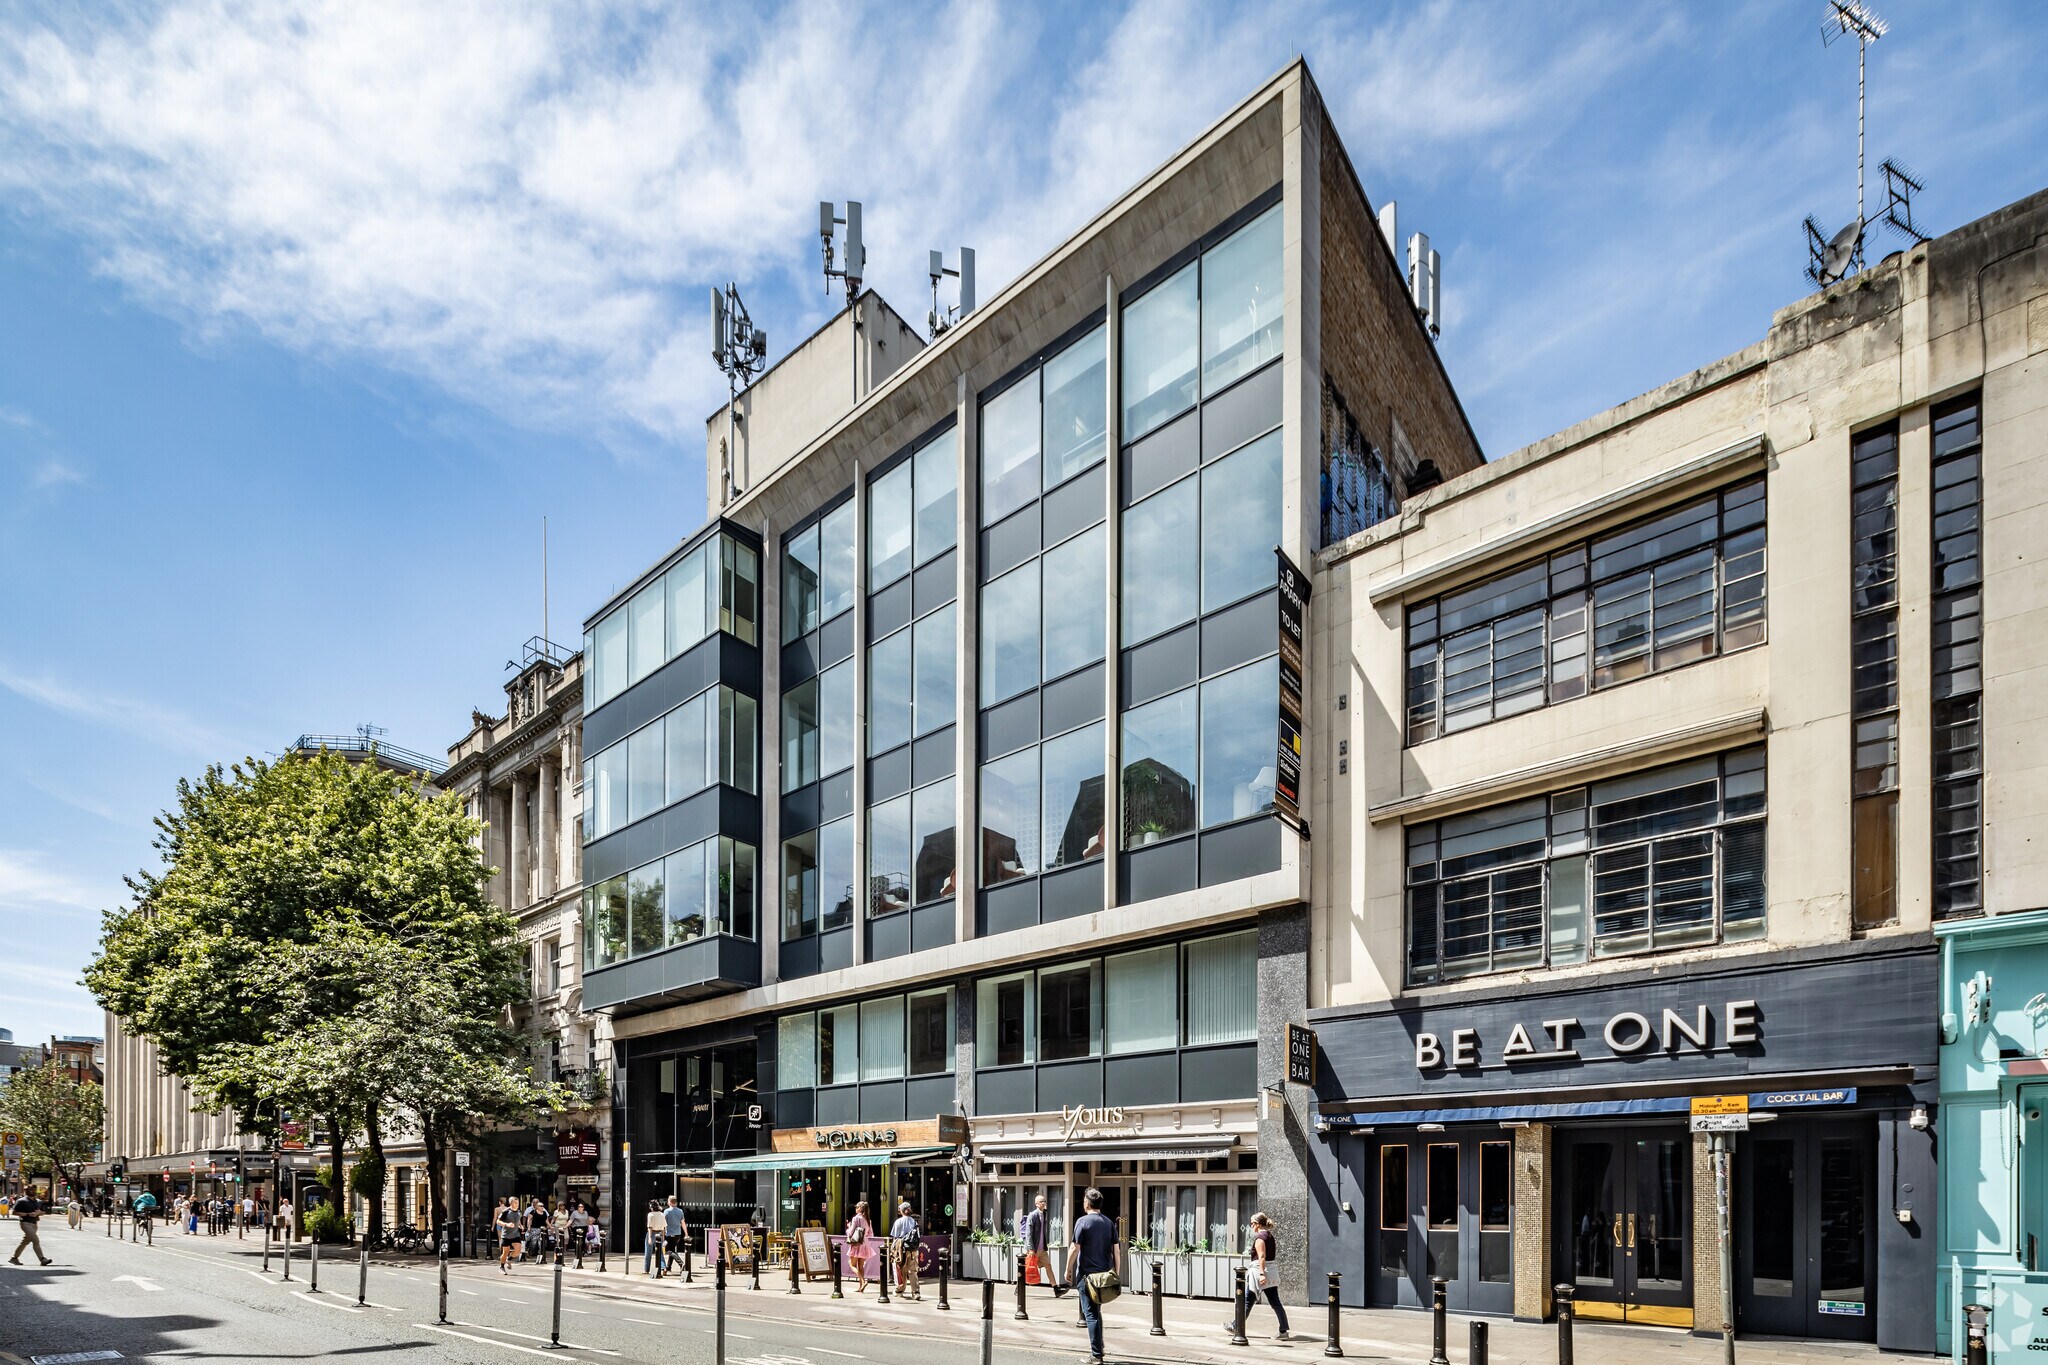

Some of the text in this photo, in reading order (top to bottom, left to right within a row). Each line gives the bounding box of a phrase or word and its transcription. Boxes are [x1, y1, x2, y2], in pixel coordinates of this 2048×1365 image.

[1281, 609, 1301, 640] TO LET
[1291, 1030, 1310, 1043] BE AT
[1416, 1000, 1756, 1069] BE AT ONE
[1291, 1041, 1310, 1058] ONE
[1291, 1063, 1310, 1081] BAR
[1766, 1092, 1844, 1104] COCKTAIL BAR
[1063, 1104, 1124, 1143] Yours
[1148, 1150, 1201, 1158] RESTAURANT
